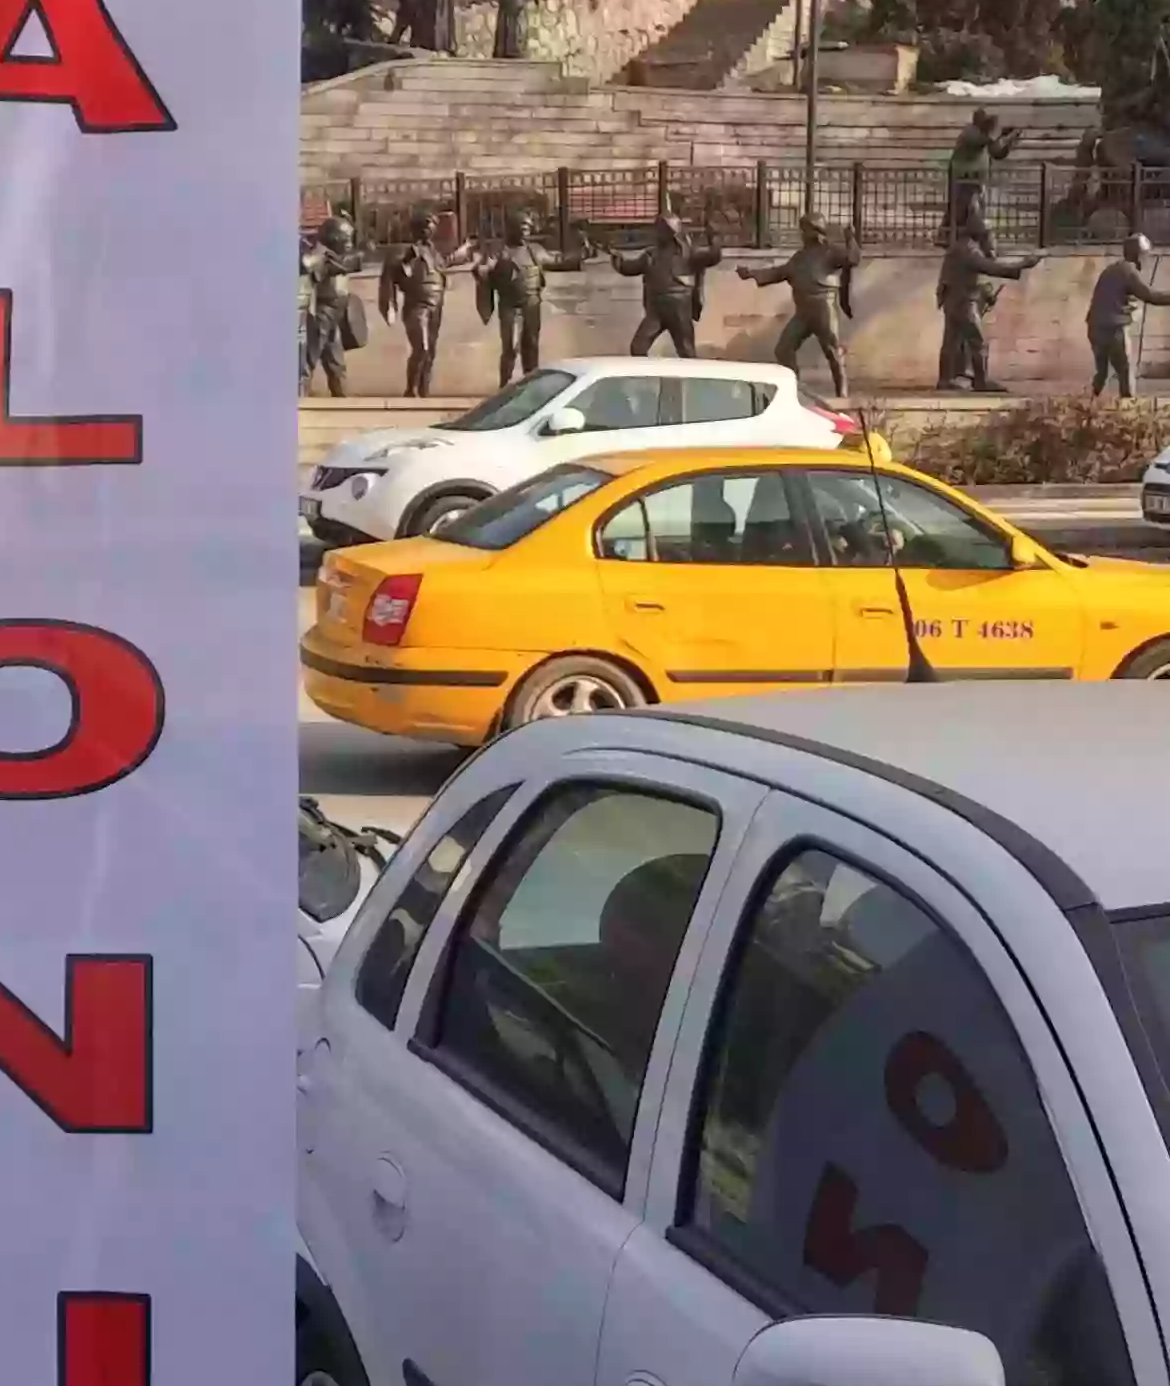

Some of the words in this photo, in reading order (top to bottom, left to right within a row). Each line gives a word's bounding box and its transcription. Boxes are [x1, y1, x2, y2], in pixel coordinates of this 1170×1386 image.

[913, 618, 942, 638] 06
[951, 617, 970, 639] T
[978, 619, 1035, 640] 4638
